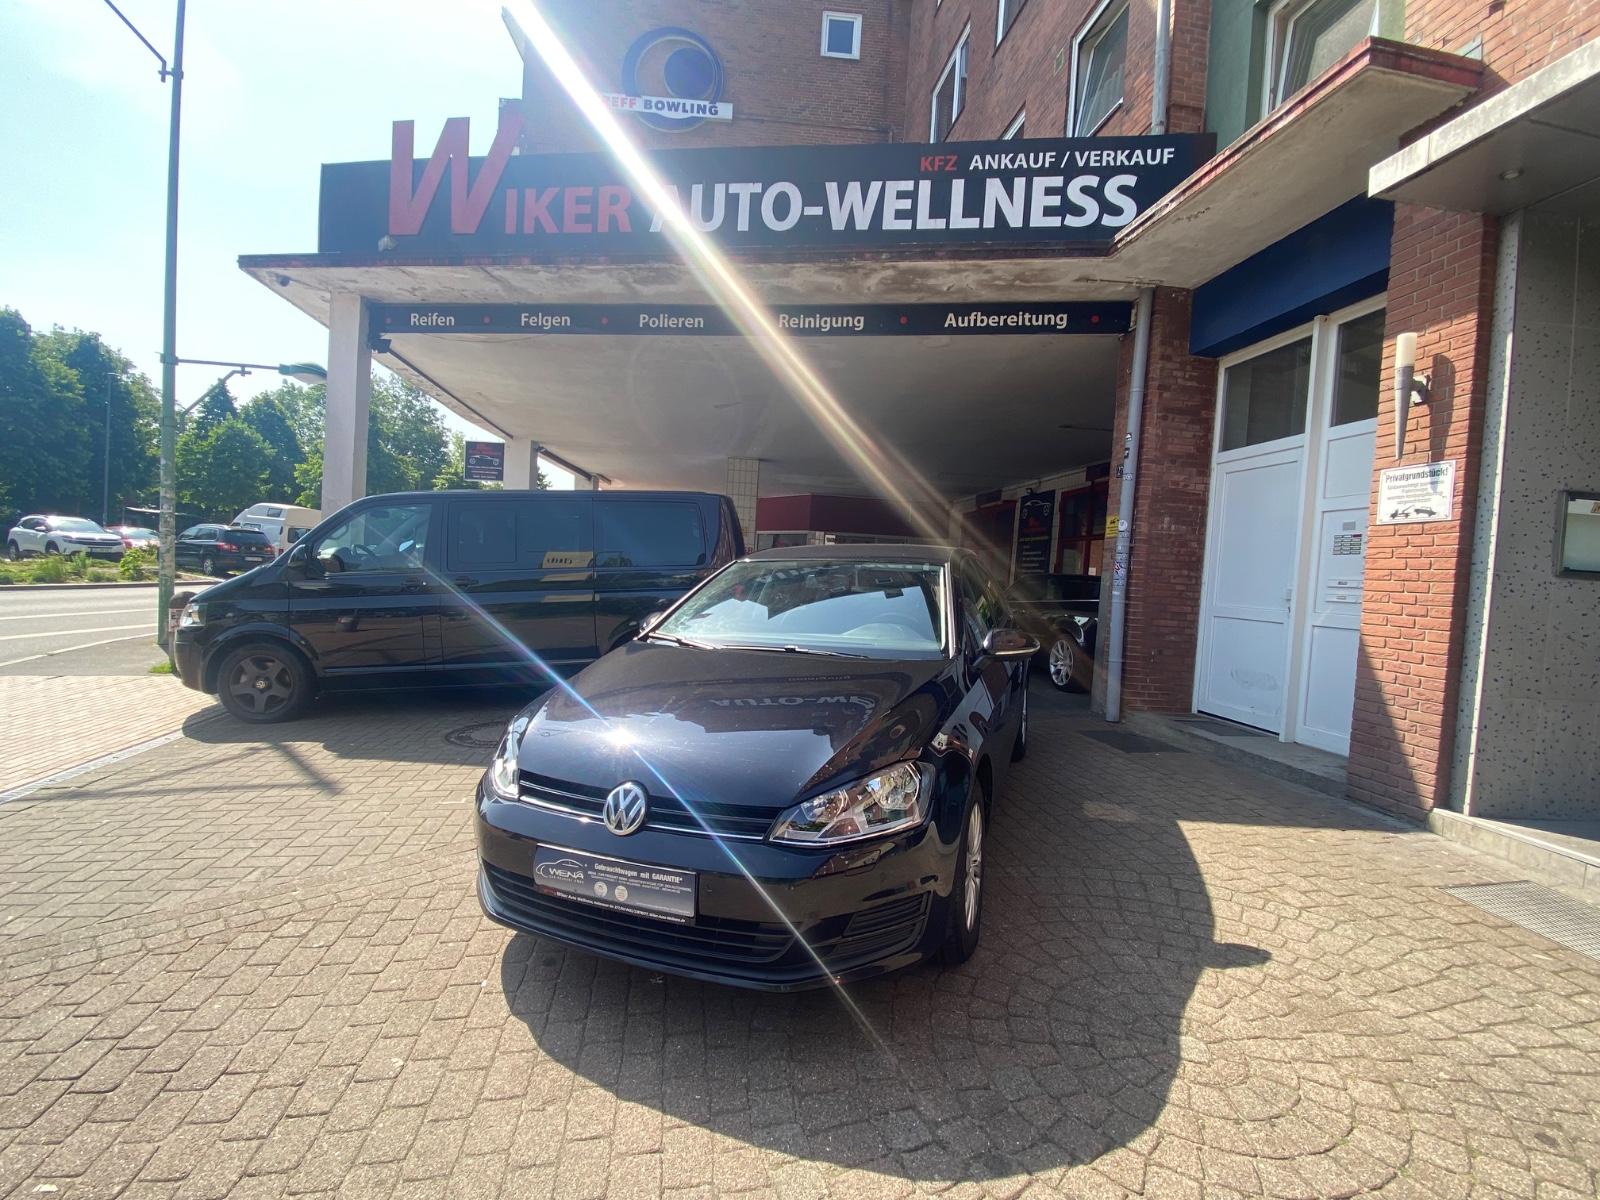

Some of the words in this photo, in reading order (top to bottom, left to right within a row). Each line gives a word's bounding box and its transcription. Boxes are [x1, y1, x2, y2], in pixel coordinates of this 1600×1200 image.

[643, 99, 719, 116] BOWLING
[919, 154, 958, 172] KFZ
[968, 150, 1057, 171] ANKAUF
[1074, 147, 1176, 168] VERKAUF
[409, 311, 456, 328] Reifen
[520, 312, 572, 331] Felgen
[638, 312, 705, 330] Polieren
[778, 312, 866, 334] Reinigung
[943, 310, 1069, 333] Aufbereitung
